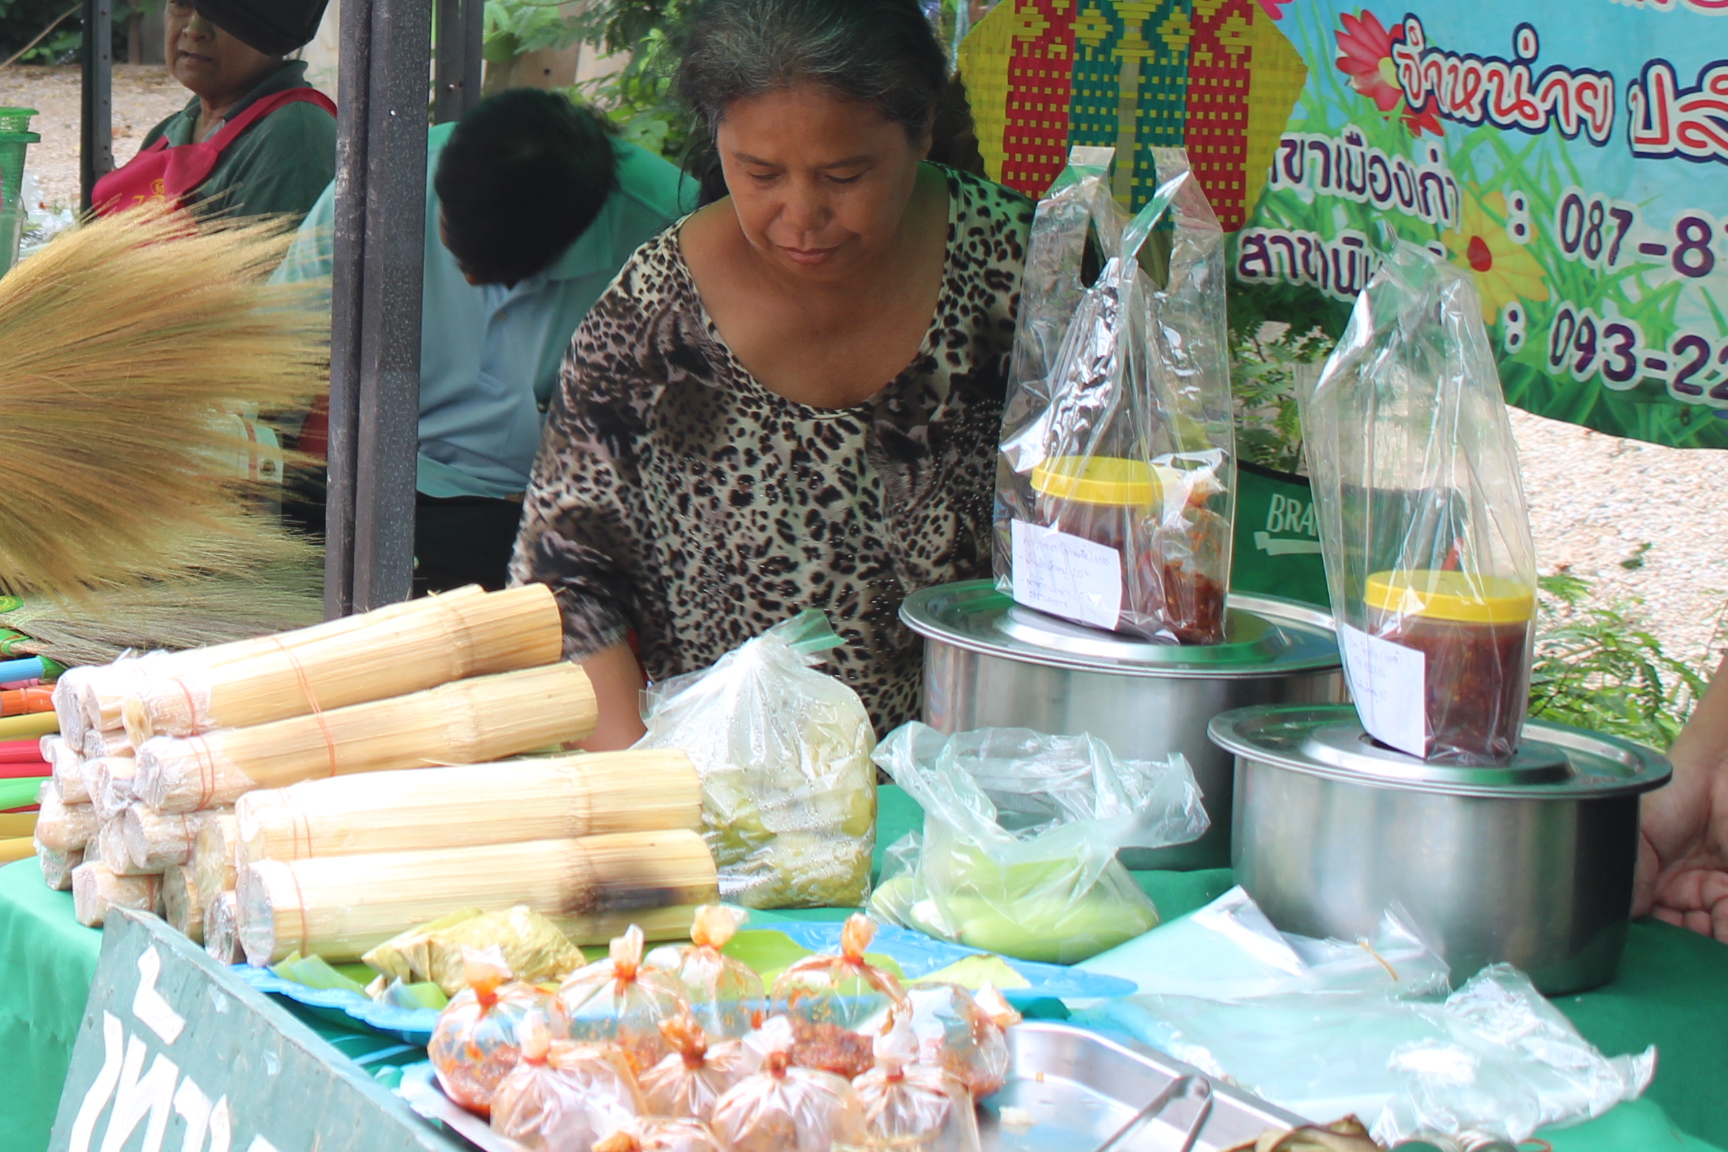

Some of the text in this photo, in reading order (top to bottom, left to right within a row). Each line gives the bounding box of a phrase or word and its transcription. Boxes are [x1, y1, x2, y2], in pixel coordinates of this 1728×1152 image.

[1393, 18, 1613, 141] จำหน่าย
[1560, 192, 1728, 279] 087-8
